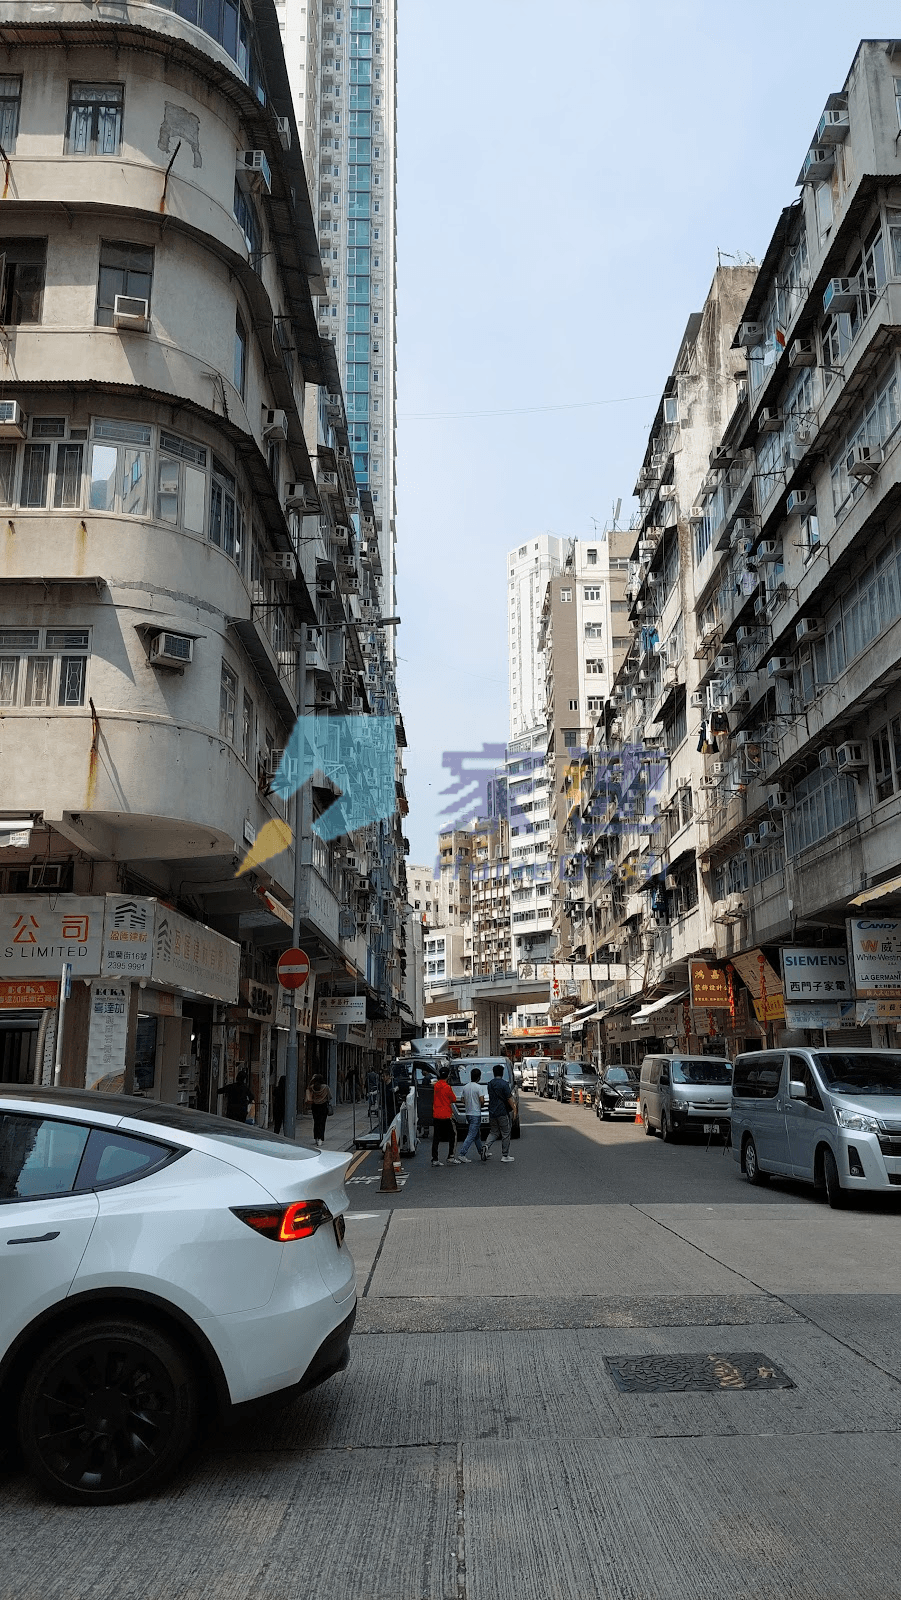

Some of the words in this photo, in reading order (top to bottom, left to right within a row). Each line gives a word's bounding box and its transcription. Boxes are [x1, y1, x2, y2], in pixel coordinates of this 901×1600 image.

[12, 915, 90, 943] 公司
[856, 920, 899, 930] CANDY
[0, 946, 14, 958] S
[20, 946, 88, 958] LIMITED
[107, 962, 126, 970] 2395
[785, 955, 846, 966] SIEMENS
[8, 985, 46, 994] ECKA
[790, 980, 846, 992] 西門子家電
[95, 988, 126, 996] ECKA
[94, 1002, 124, 1014] 喜達加
